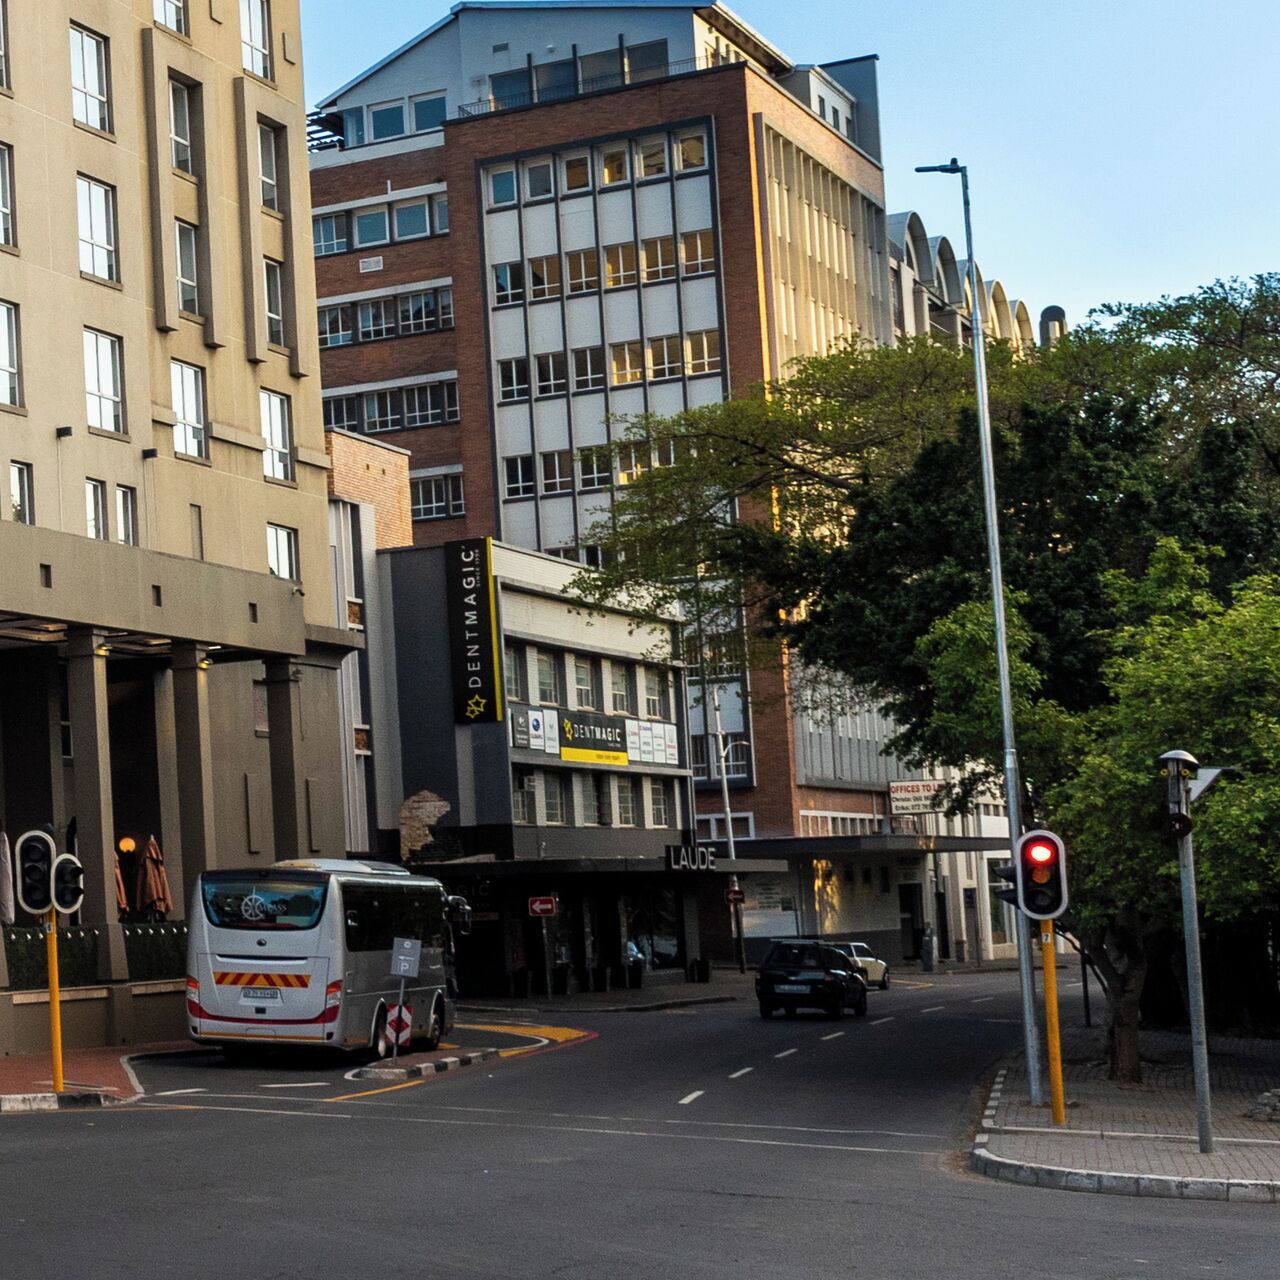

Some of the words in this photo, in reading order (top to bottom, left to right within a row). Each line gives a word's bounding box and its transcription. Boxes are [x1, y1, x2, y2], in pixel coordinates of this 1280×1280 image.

[461, 550, 482, 688] DENTMAGIC
[573, 724, 622, 742] DENTMAGIC
[891, 784, 920, 794] OFFICES
[921, 784, 931, 793] TO
[670, 846, 717, 870] LAUDE
[401, 963, 410, 972] P
